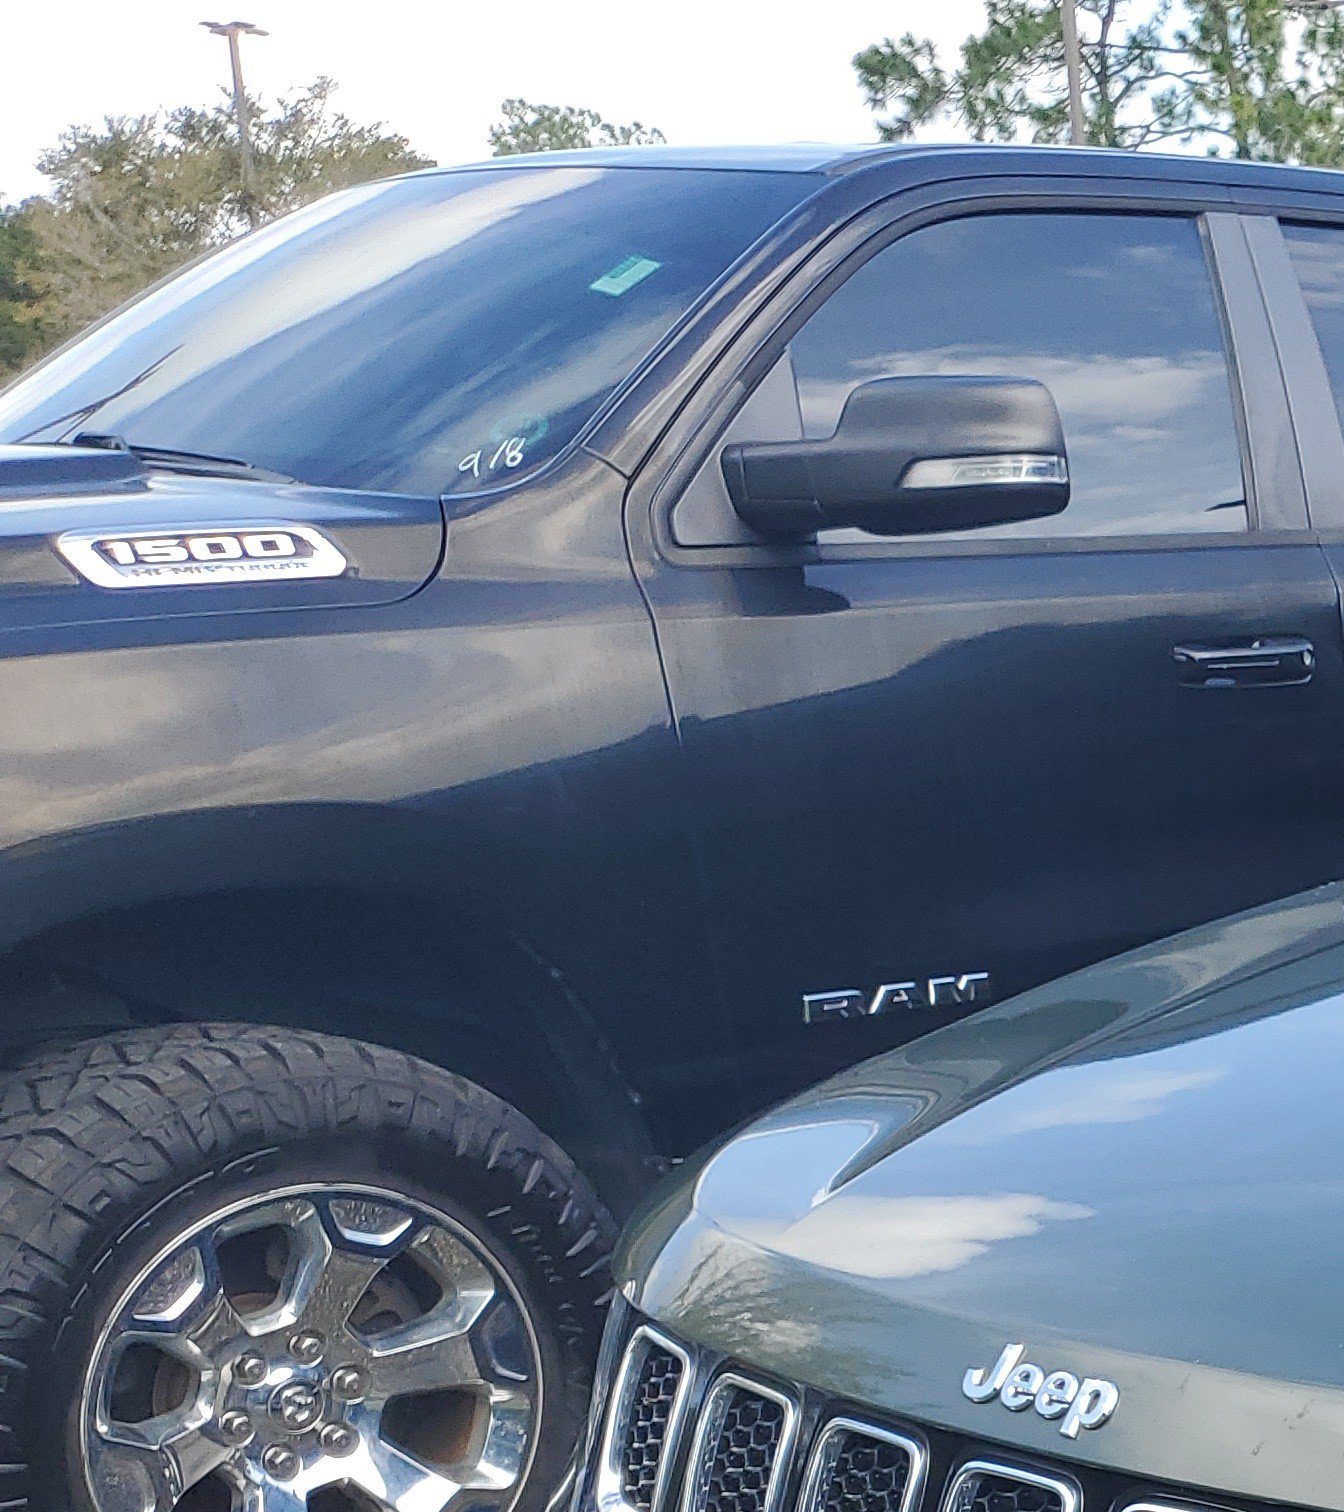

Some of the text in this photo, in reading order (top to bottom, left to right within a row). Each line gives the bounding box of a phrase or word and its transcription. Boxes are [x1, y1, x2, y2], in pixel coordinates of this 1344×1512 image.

[458, 437, 526, 478] 9/8
[100, 534, 297, 565] 1500
[803, 971, 989, 1024] RAM
[962, 1342, 1120, 1440] Jeep
